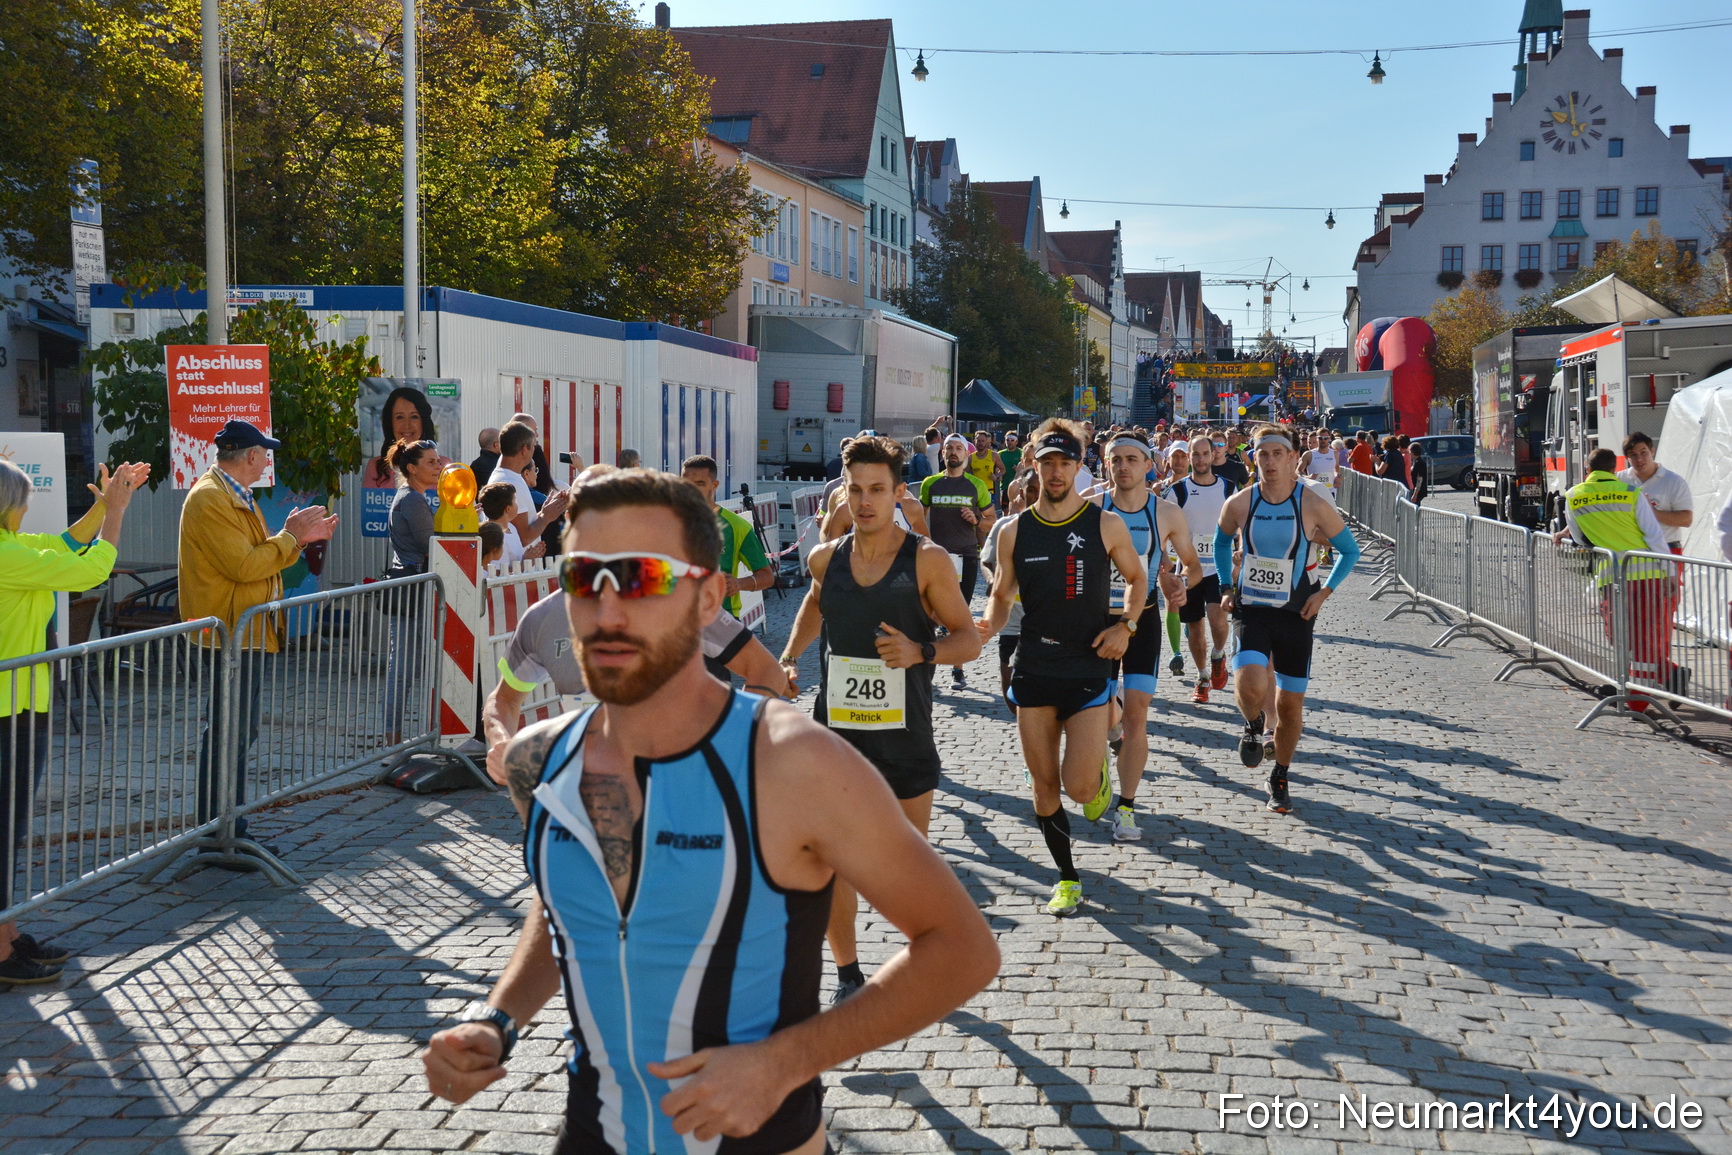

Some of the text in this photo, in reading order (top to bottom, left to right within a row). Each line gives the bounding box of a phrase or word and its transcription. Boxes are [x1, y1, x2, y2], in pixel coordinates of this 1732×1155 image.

[75, 239, 102, 250] Parkschein
[78, 251, 101, 262] werktags
[176, 354, 263, 370] Abschluss
[176, 371, 205, 380] statt
[1206, 365, 1243, 375] START
[177, 382, 264, 395] Ausschluss!
[193, 402, 261, 413] Mehr Lehrer für
[189, 414, 226, 423] kleinere
[932, 495, 973, 506] BOCK
[1573, 493, 1628, 506] Org.-Leiter
[366, 521, 387, 531] CSU
[1066, 555, 1075, 574] ROTH
[1249, 568, 1284, 585] 2393
[1066, 586, 1075, 599] TSG
[1253, 590, 1276, 599] Thomas
[850, 664, 882, 674] BOCK
[845, 678, 887, 700] 248
[850, 712, 882, 722] Patrick
